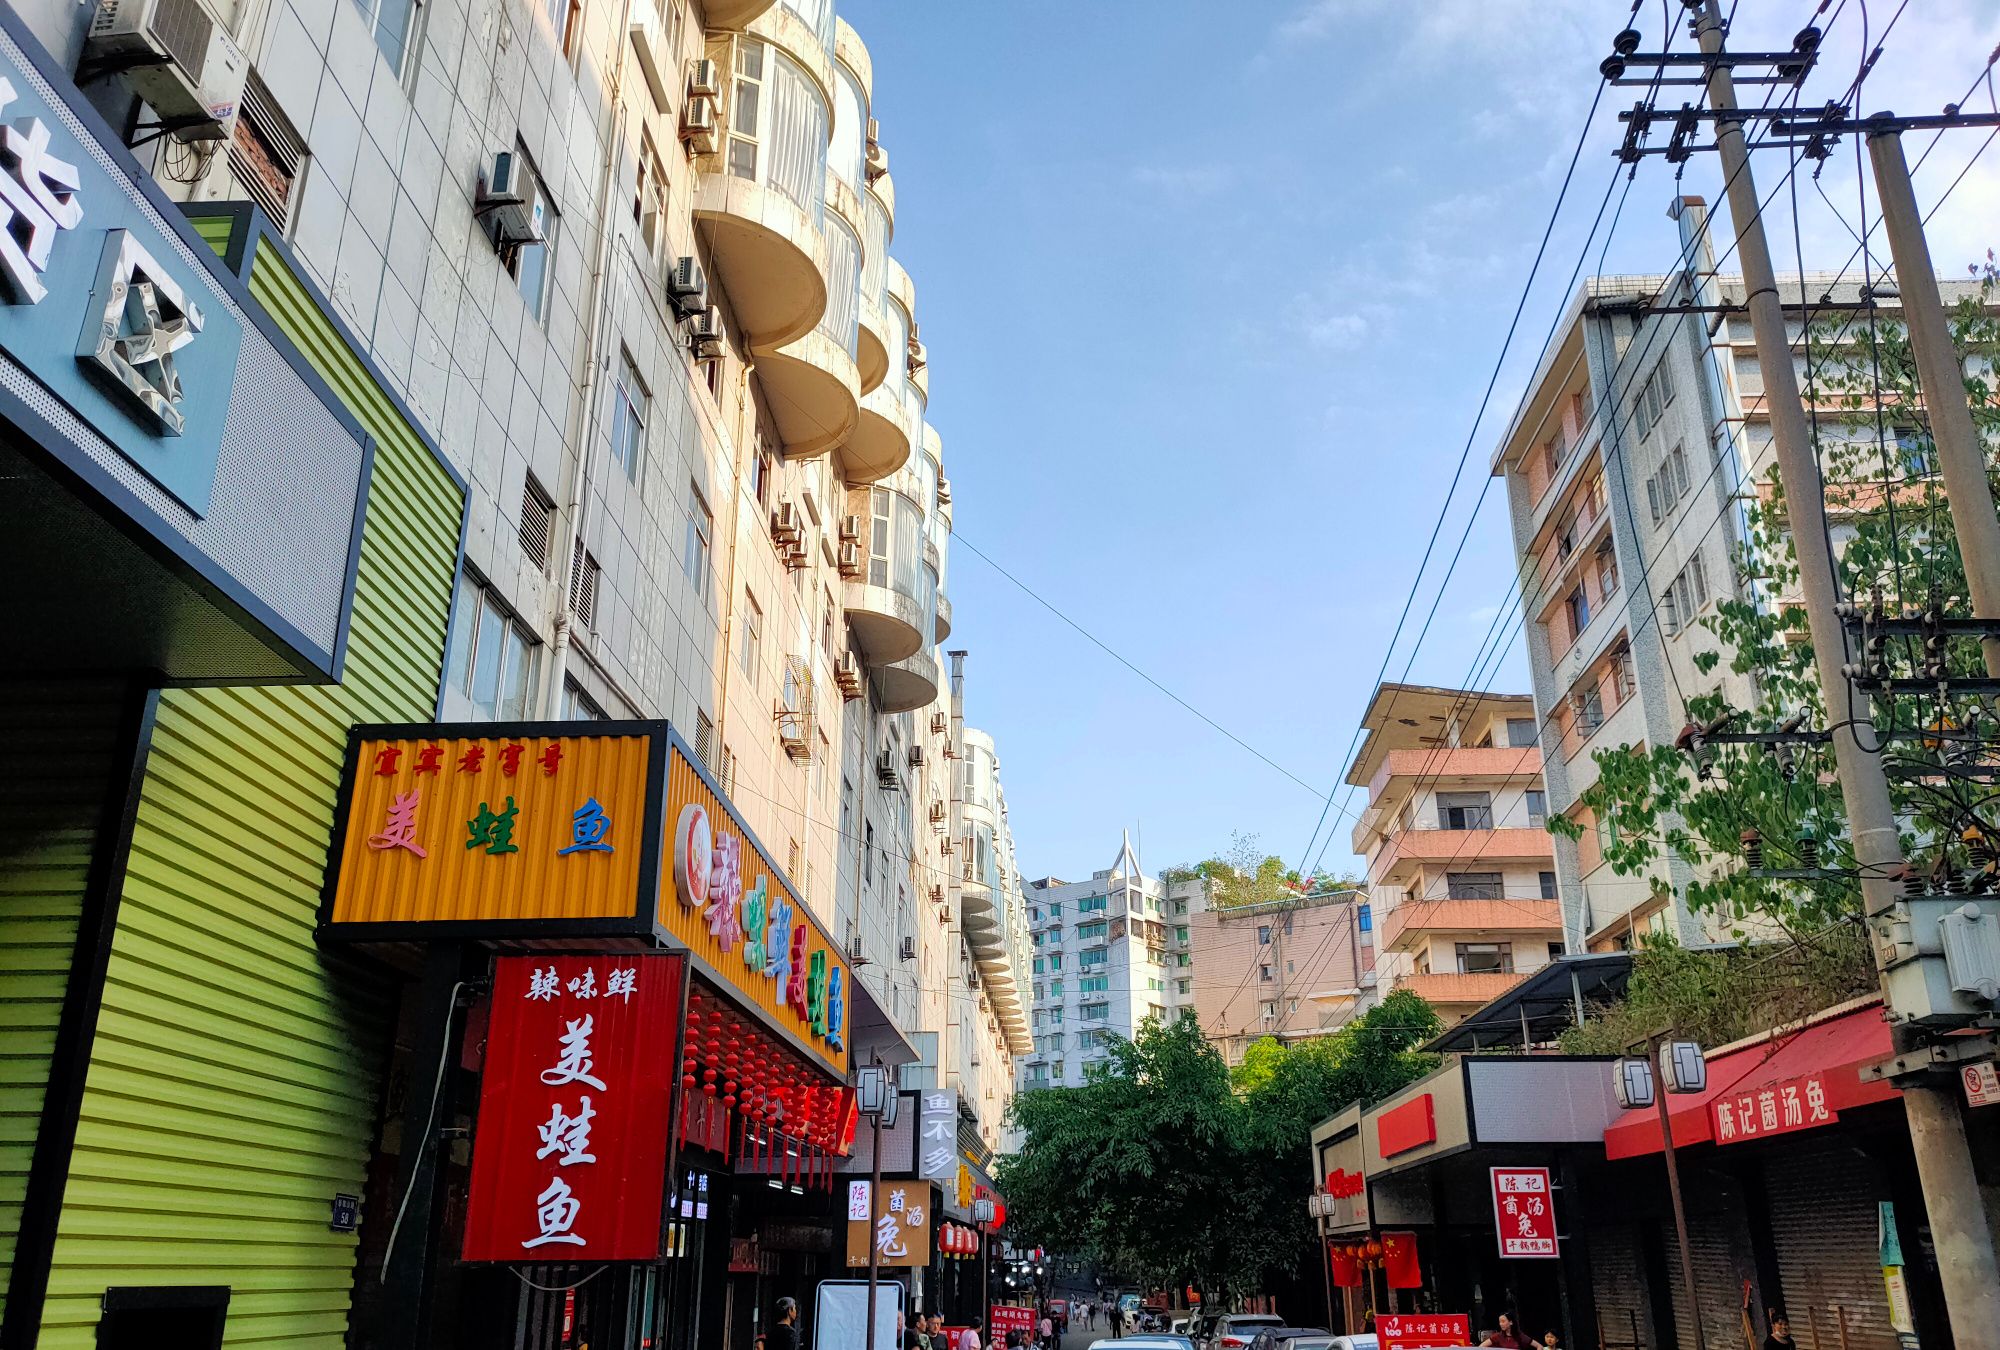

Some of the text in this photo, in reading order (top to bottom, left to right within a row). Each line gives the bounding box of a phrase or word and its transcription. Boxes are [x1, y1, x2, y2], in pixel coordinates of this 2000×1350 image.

[374, 743, 563, 777] 宜宾老字号
[367, 788, 615, 859] 美蛙鱼
[524, 965, 638, 1004] 辣味鲜
[521, 1013, 607, 1248] 美蛙鱼
[922, 1093, 954, 1175] 鱼不多
[1717, 1079, 1829, 1141] 陈记菌汤兔
[850, 1183, 867, 1218] 陈记
[1505, 1176, 1541, 1191] 陈记
